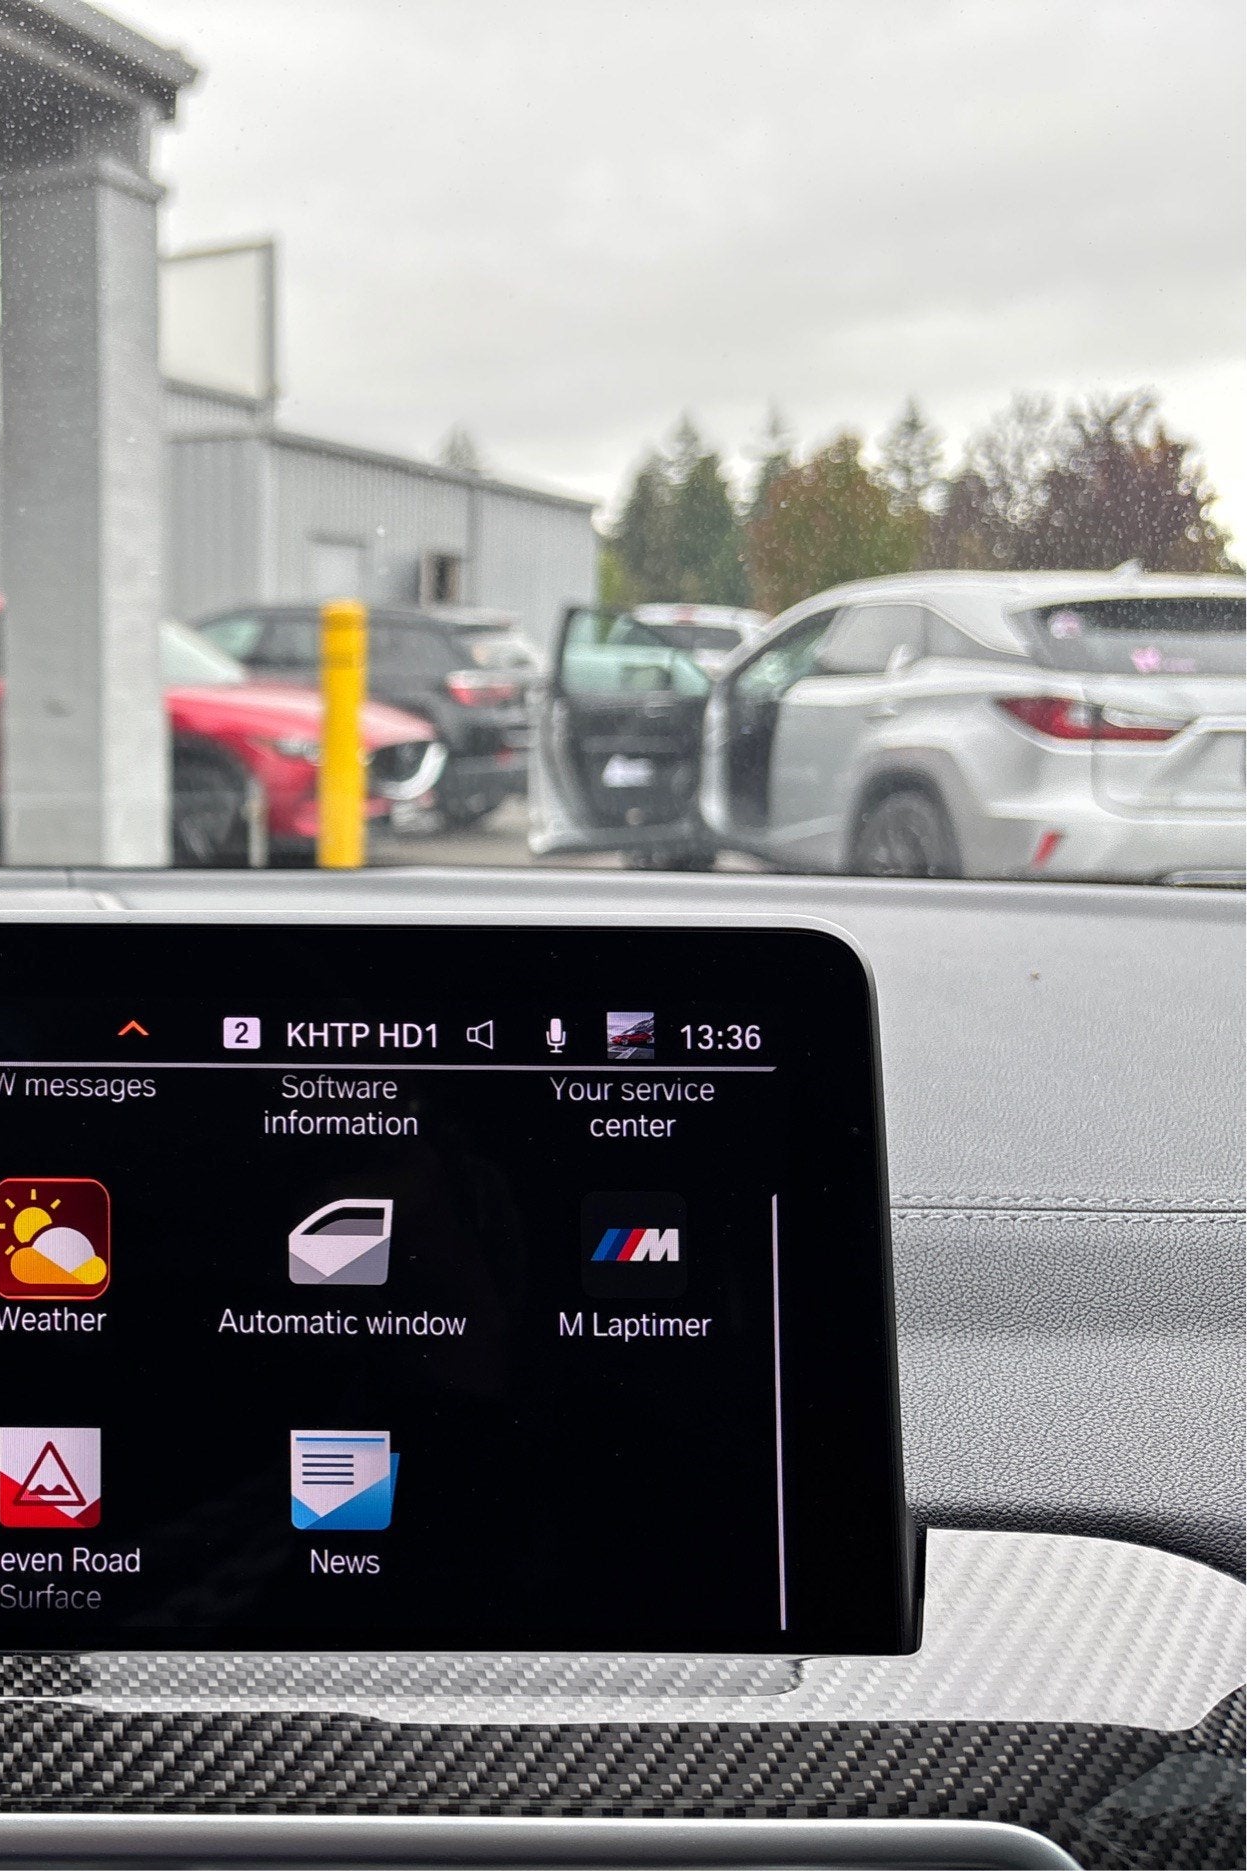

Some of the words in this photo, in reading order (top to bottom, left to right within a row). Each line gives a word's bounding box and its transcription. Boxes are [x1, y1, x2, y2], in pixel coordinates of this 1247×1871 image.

[234, 1021, 250, 1045] 2
[286, 1021, 371, 1049] KHTP
[378, 1022, 438, 1049] HD1
[679, 1023, 762, 1051] 13:36
[24, 1077, 157, 1103] messages
[281, 1073, 399, 1100] Software
[549, 1076, 614, 1102] Your
[620, 1076, 716, 1102] service
[263, 1109, 419, 1136] information
[588, 1113, 678, 1138] center
[217, 1307, 359, 1336] Automatic
[364, 1309, 467, 1337] window
[559, 1311, 584, 1337] M
[593, 1311, 713, 1342] Laptimer
[71, 1545, 142, 1573] Road
[310, 1547, 381, 1575] News
[0, 1582, 102, 1610] Surface
